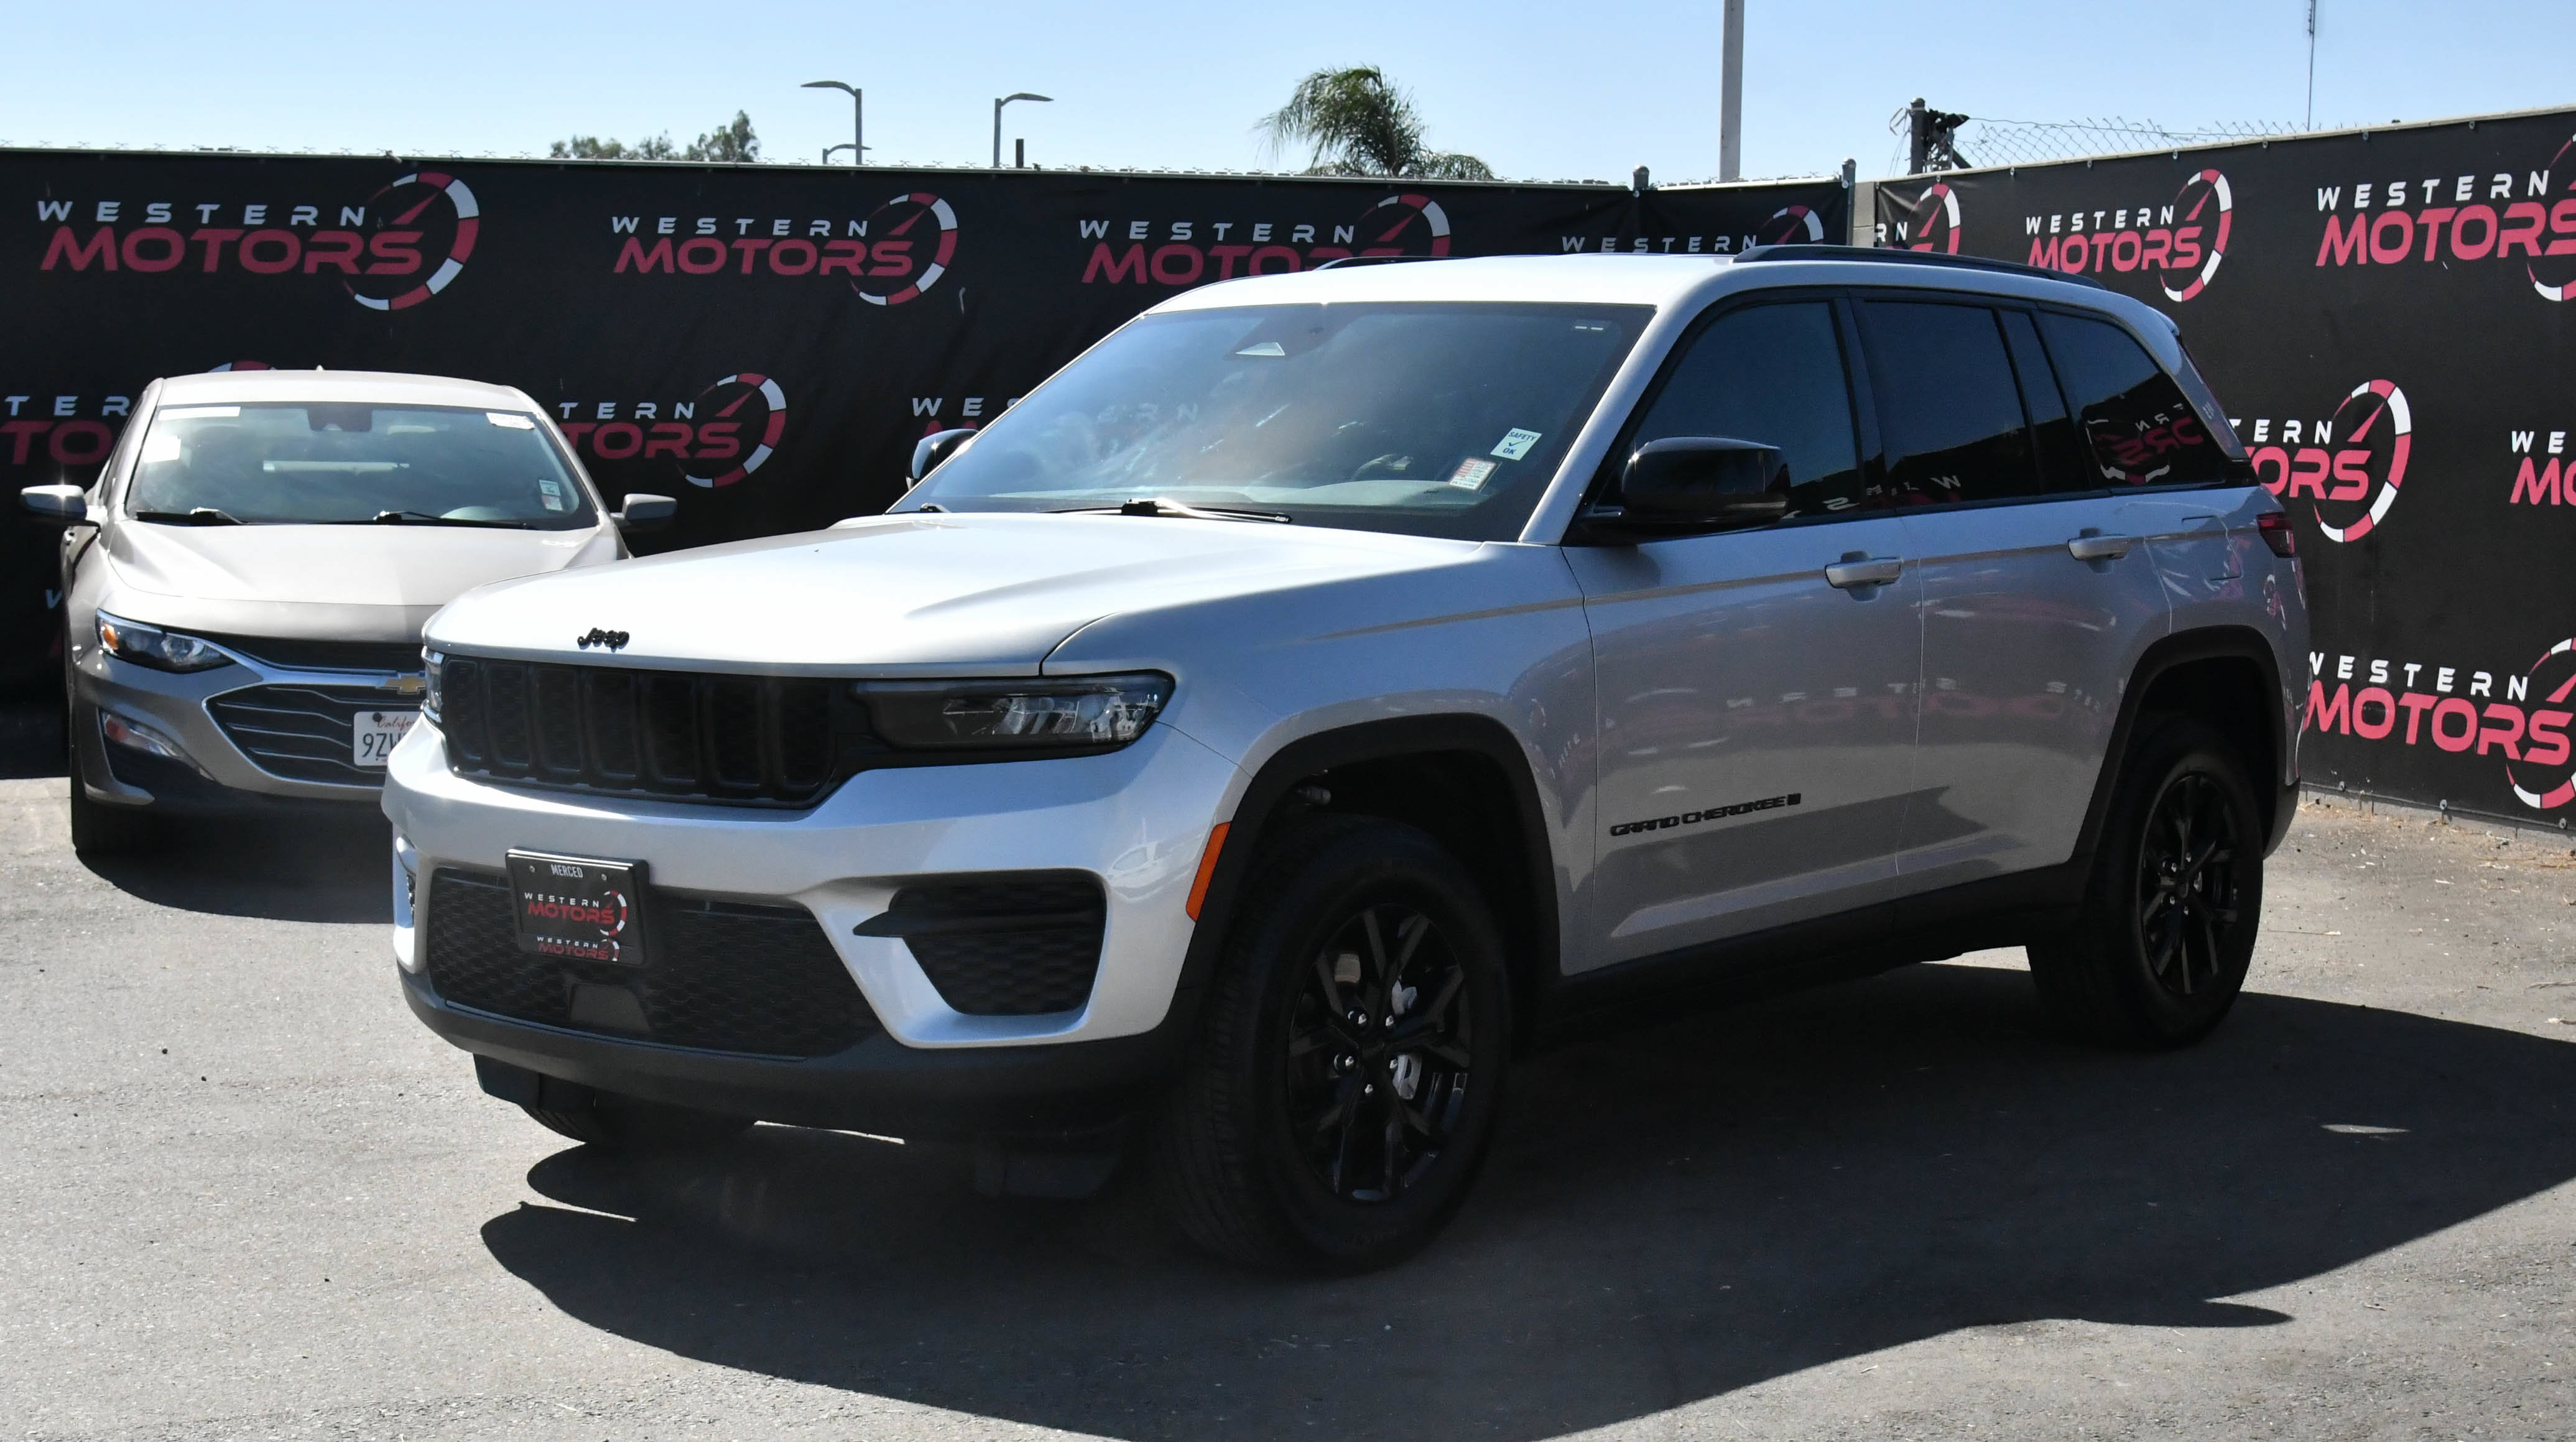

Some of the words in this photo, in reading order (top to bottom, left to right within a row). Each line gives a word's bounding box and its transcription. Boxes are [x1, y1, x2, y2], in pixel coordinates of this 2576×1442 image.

[2317, 170, 2549, 211] WESTERN
[37, 200, 365, 226] WESTERN
[2026, 205, 2174, 235] WESTERN
[612, 216, 868, 236] WESTERN
[1080, 220, 1354, 244] WESTERN
[2315, 198, 2576, 267] MOTORS
[39, 226, 424, 275] MOTORS
[613, 237, 914, 276] MOTORS
[1562, 234, 1757, 254] WESTERN
[2027, 226, 2202, 274] MOTORS
[1508, 432, 1537, 441] SAFETY
[577, 627, 629, 650] Jeep
[2309, 651, 2528, 702] WESTERN
[2302, 679, 2574, 765] MOTORS
[1610, 816, 1680, 836] GRAND
[1682, 796, 1786, 824] CHEROKEE
[550, 864, 583, 878] MERCED
[524, 892, 600, 907] WESTERN
[528, 901, 615, 925] MOTORS
[537, 936, 598, 949] WESTERN
[539, 943, 609, 960] MOTORS
